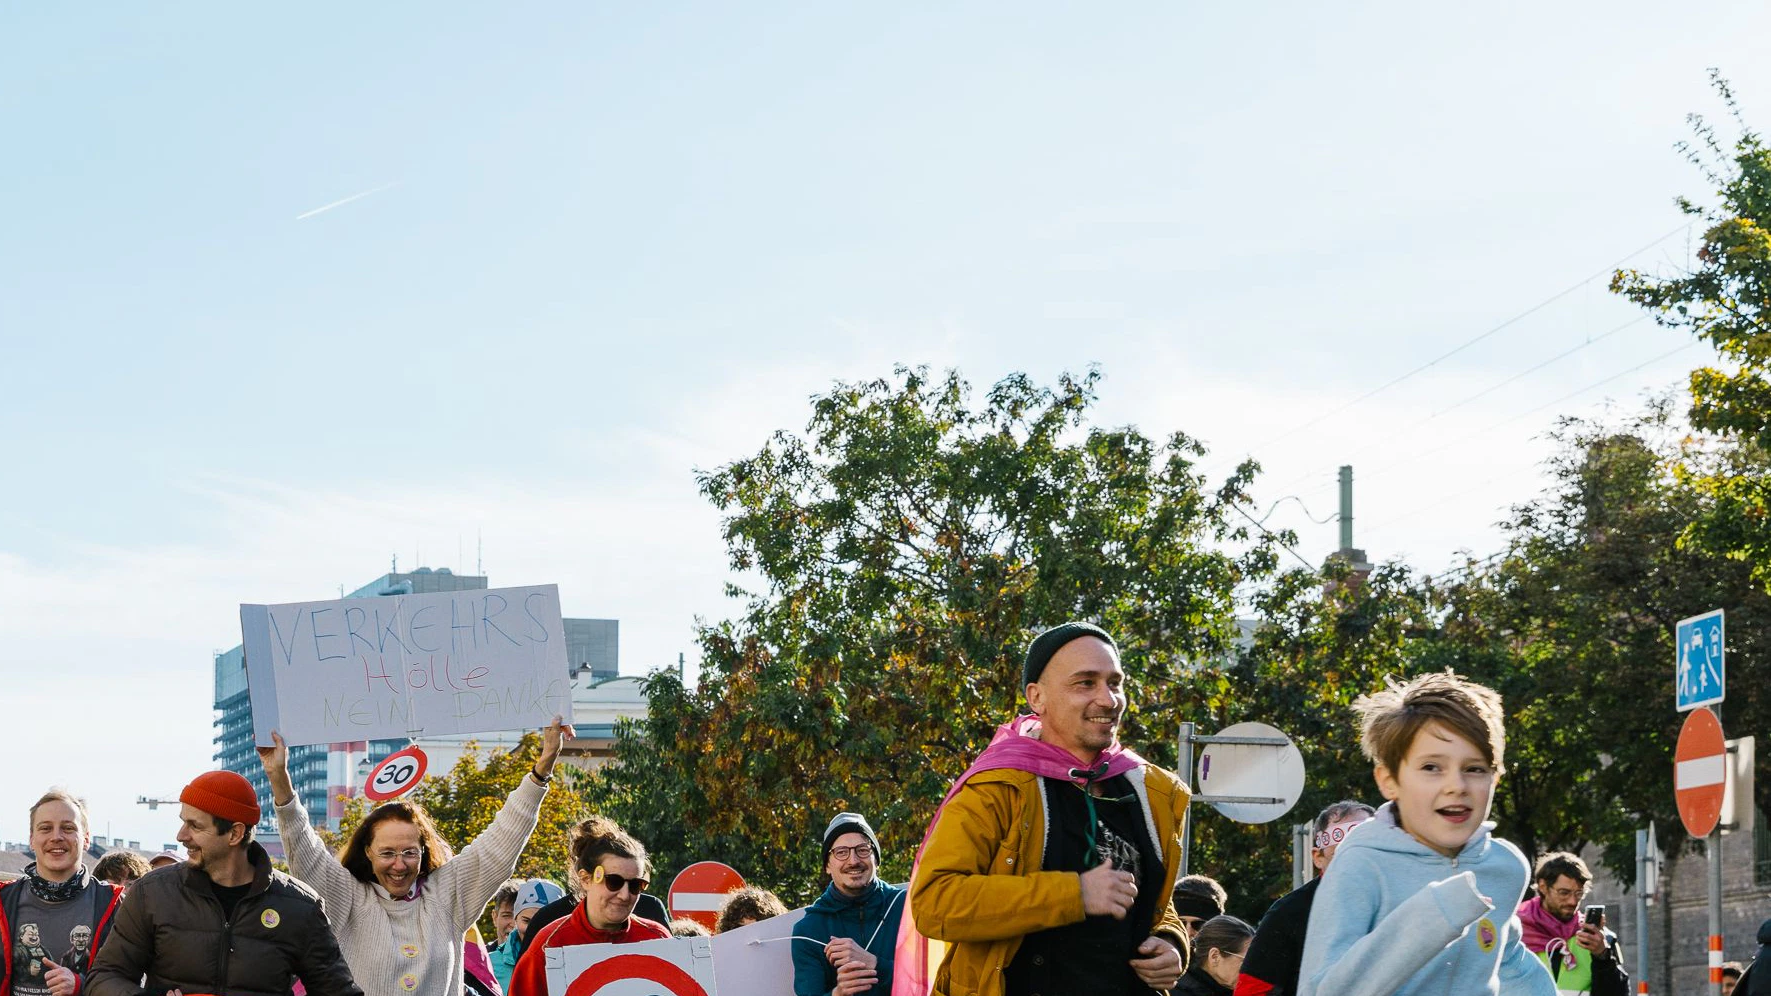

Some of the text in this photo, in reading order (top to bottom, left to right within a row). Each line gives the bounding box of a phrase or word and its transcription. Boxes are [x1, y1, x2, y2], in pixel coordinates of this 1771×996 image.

[269, 593, 549, 666] VERKEHRS
[323, 692, 415, 728] NEIN
[375, 763, 414, 786] 30
